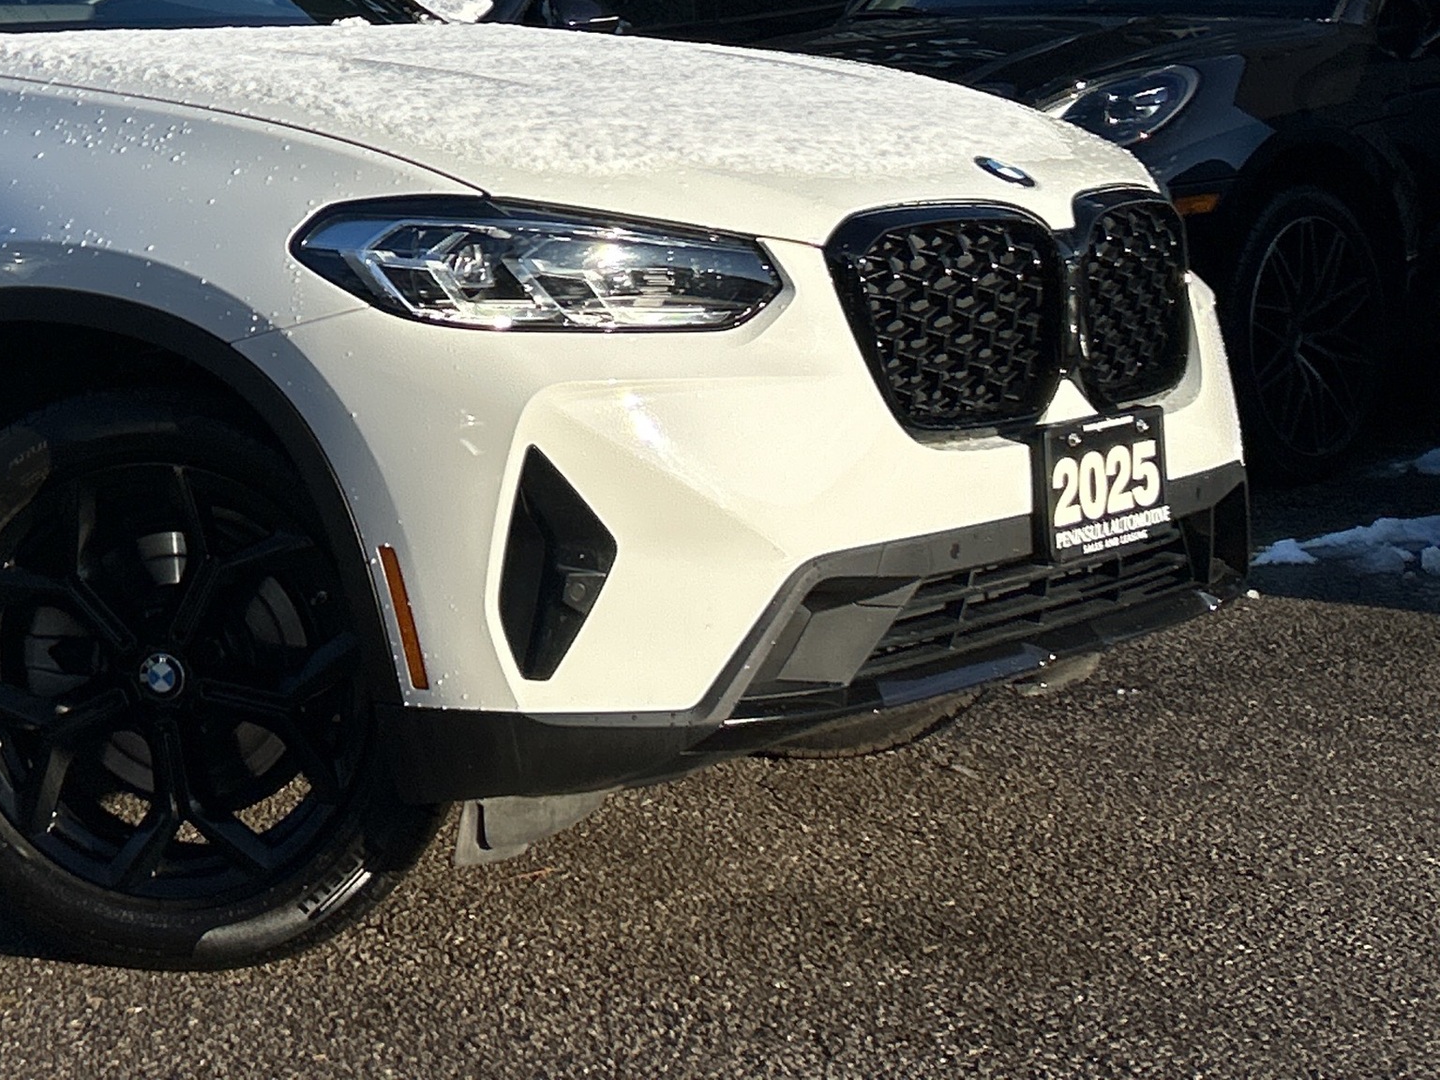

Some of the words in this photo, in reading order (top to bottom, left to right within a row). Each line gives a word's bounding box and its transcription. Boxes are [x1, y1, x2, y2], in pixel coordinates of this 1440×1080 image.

[1052, 439, 1160, 527] 2025
[1056, 522, 1111, 549] PENINSULA
[1111, 505, 1170, 534] AUTOMOTIVE
